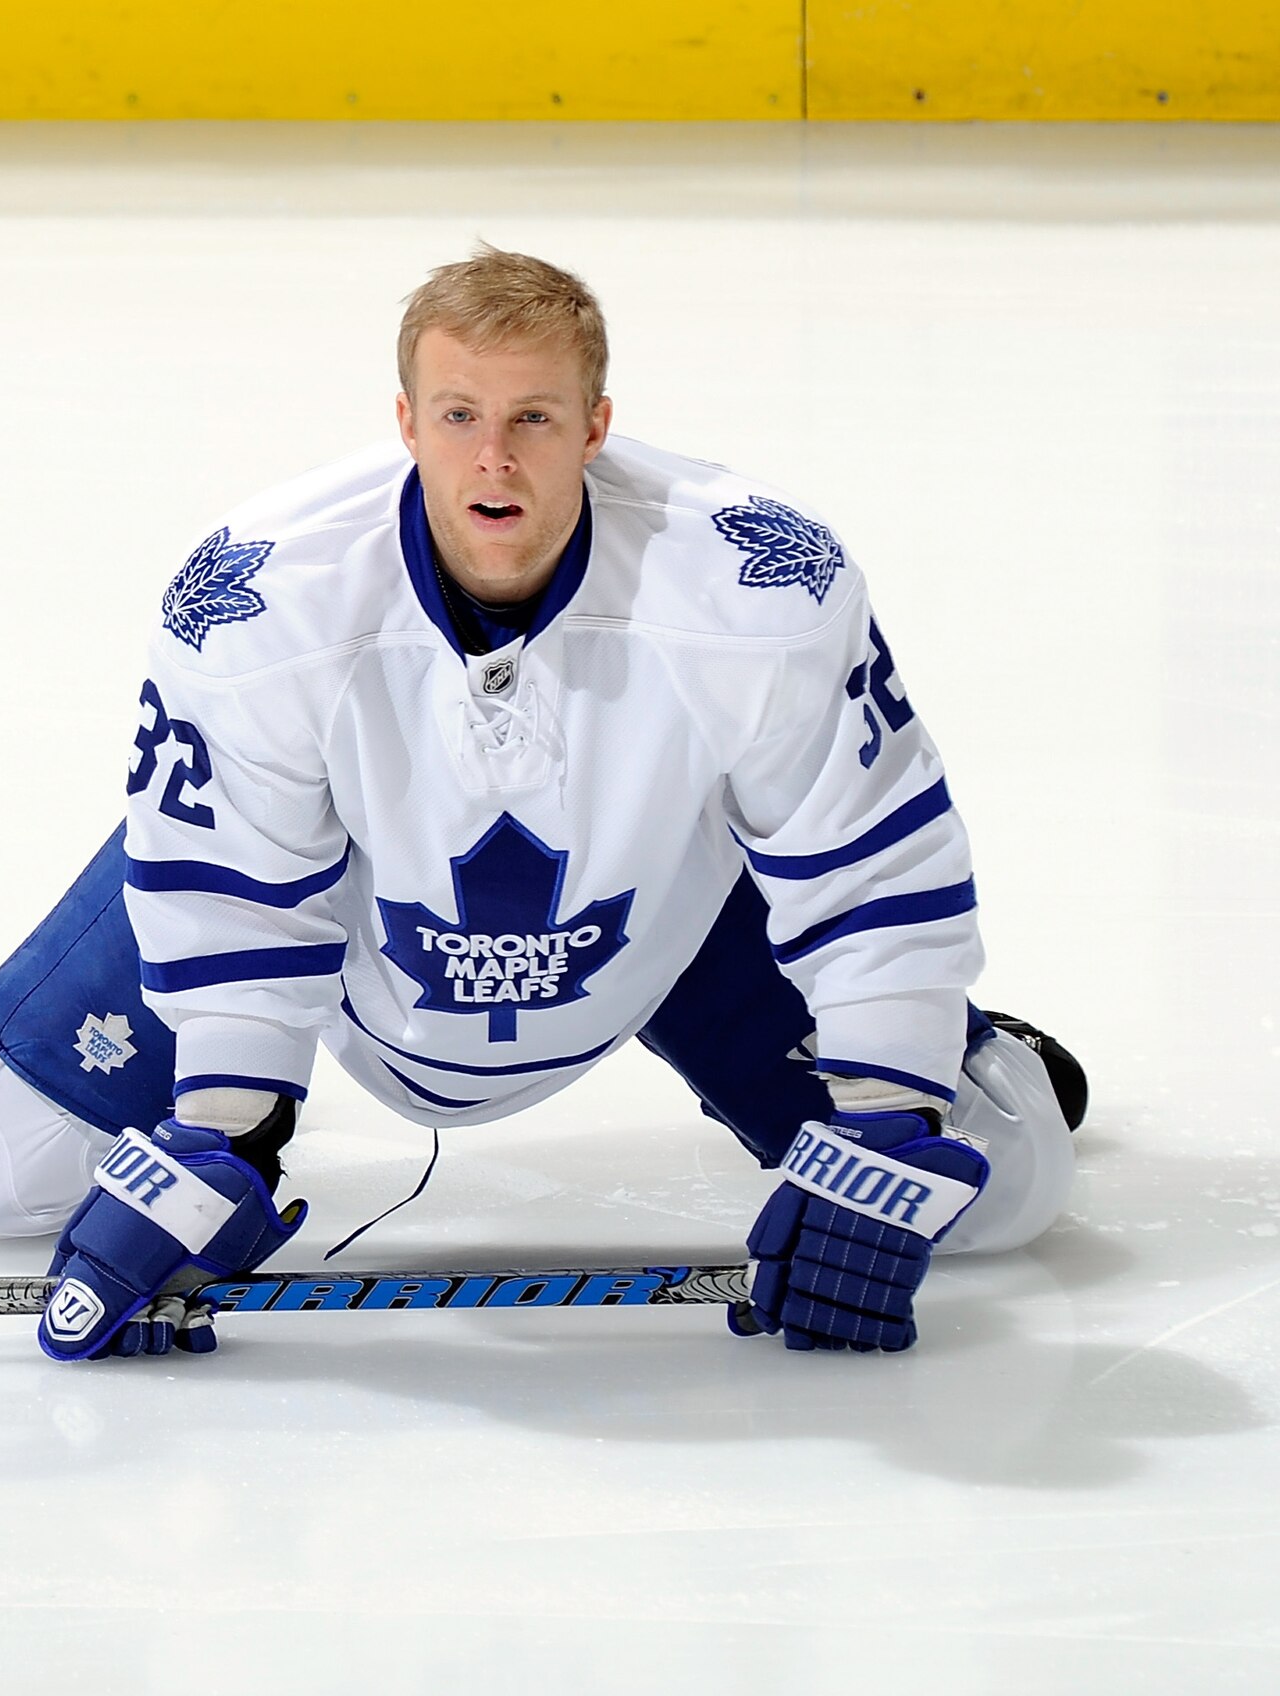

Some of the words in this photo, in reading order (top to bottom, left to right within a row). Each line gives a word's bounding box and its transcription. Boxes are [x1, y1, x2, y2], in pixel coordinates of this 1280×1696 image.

[126, 678, 216, 830] 32
[416, 925, 602, 958] TORONTO
[444, 952, 569, 980] MAPLE
[453, 976, 560, 1003] LEAFS
[85, 1044, 108, 1063] LEAFS
[88, 1026, 123, 1056] TORONTO
[88, 1037, 114, 1059] MAPLE
[187, 1272, 665, 1312] ARRIOR
